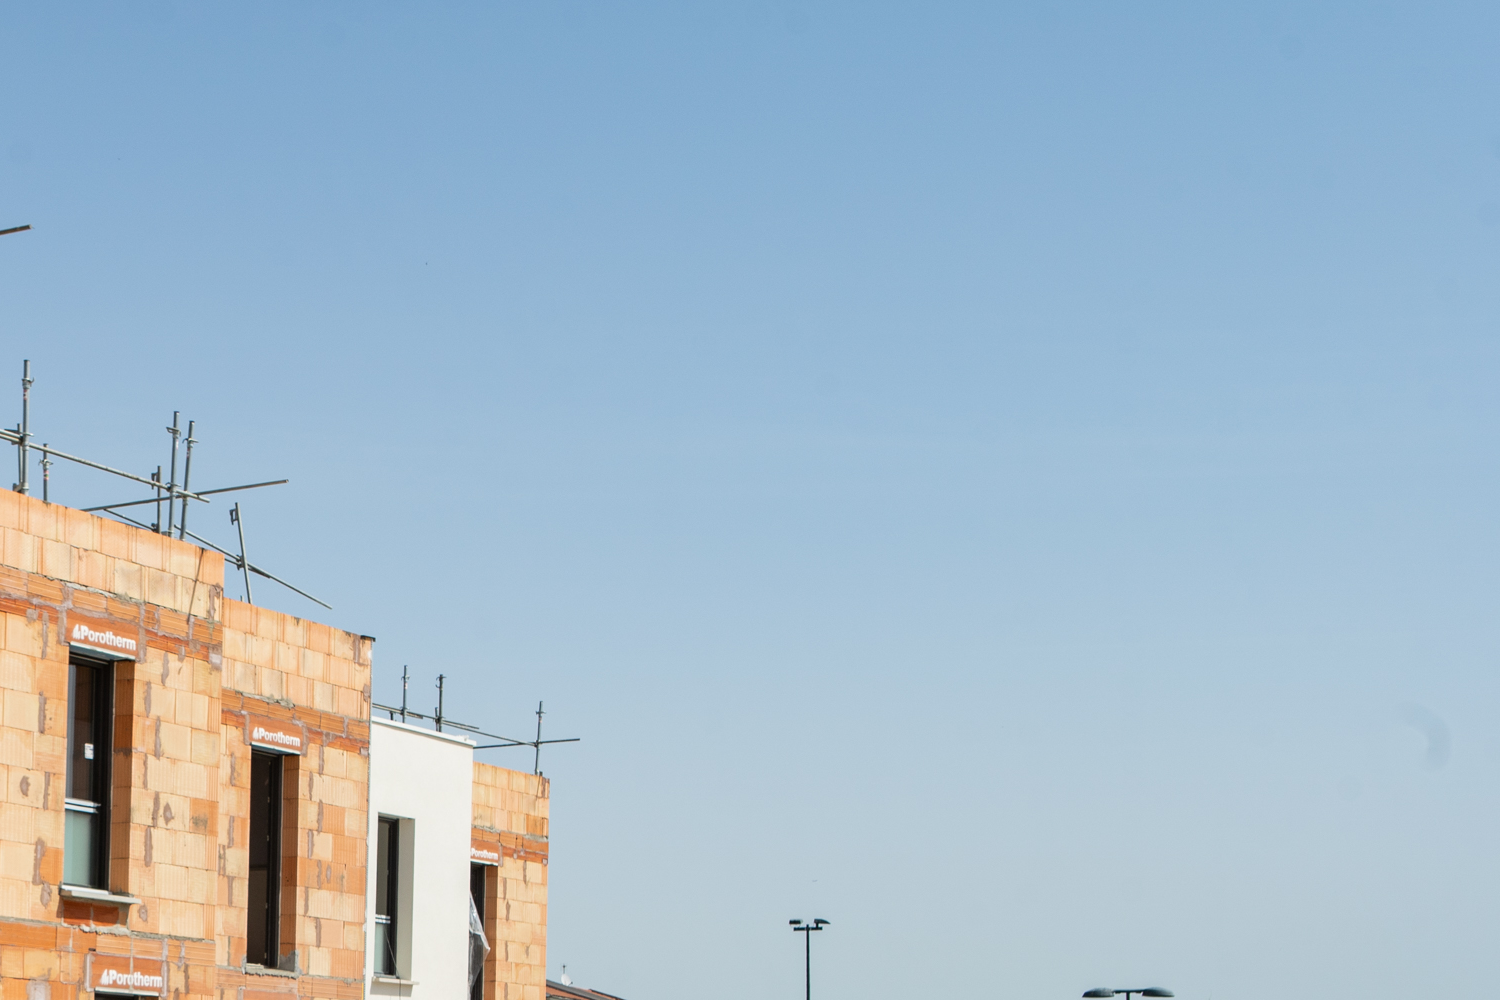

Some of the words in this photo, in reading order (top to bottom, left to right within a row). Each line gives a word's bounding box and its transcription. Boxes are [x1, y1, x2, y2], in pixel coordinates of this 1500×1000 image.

[80, 624, 136, 651] Porotherm
[258, 726, 301, 748] Porotherm
[108, 969, 164, 988] Porotherm
